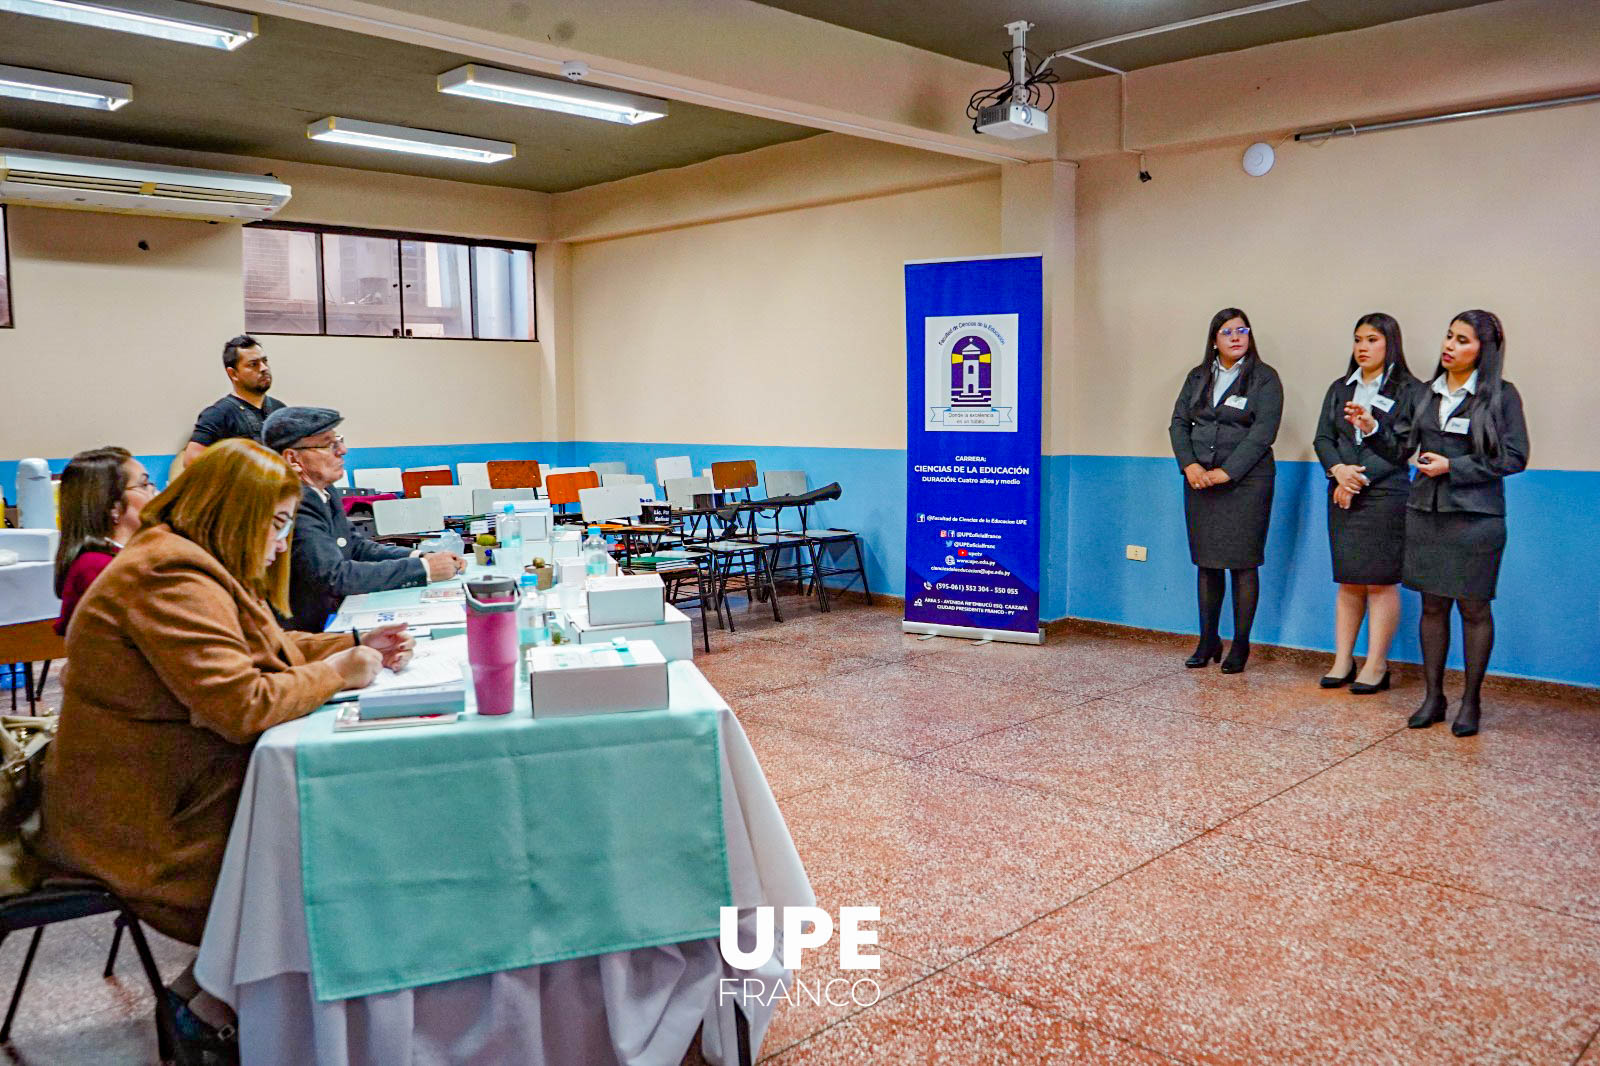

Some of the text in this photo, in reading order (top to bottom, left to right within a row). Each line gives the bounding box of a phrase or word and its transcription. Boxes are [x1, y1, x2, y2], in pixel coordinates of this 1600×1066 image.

[939, 328, 953, 346] Facultad
[988, 325, 1006, 345] Educación
[914, 465, 952, 473] CIENCIAS
[979, 466, 1030, 475] EDUCACIÓN
[980, 477, 994, 485] años
[936, 583, 965, 592] (595-061)
